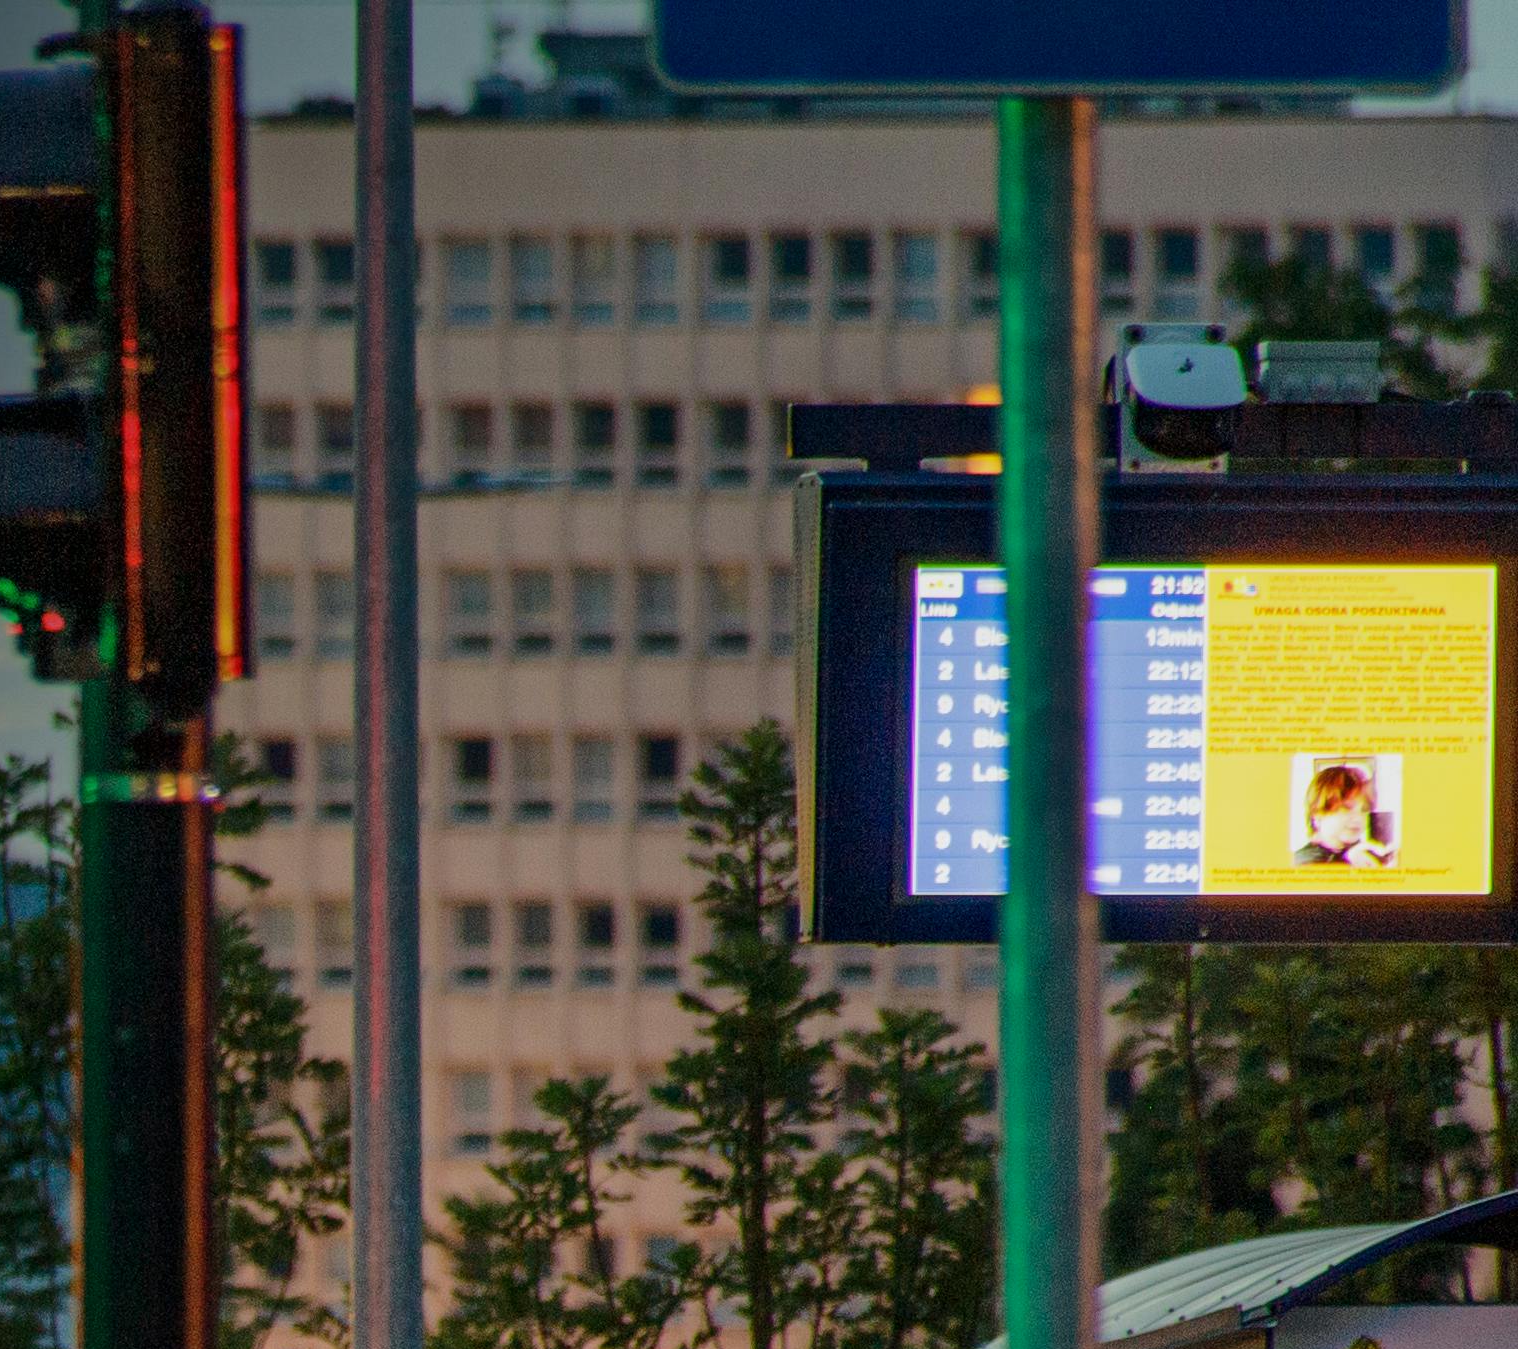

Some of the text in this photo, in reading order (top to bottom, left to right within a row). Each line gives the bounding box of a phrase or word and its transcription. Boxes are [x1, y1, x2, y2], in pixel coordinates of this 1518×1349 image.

[1254, 605, 1301, 617] UWAGA
[1305, 605, 1348, 617] OSOBA
[938, 626, 954, 646] 4
[938, 660, 954, 681] 2
[1147, 660, 1203, 681] 22:12
[937, 693, 954, 715] 9
[936, 727, 952, 748] 4
[936, 762, 952, 782] 2
[935, 795, 952, 816] 4
[935, 829, 951, 850] 9
[934, 863, 951, 884] 2
